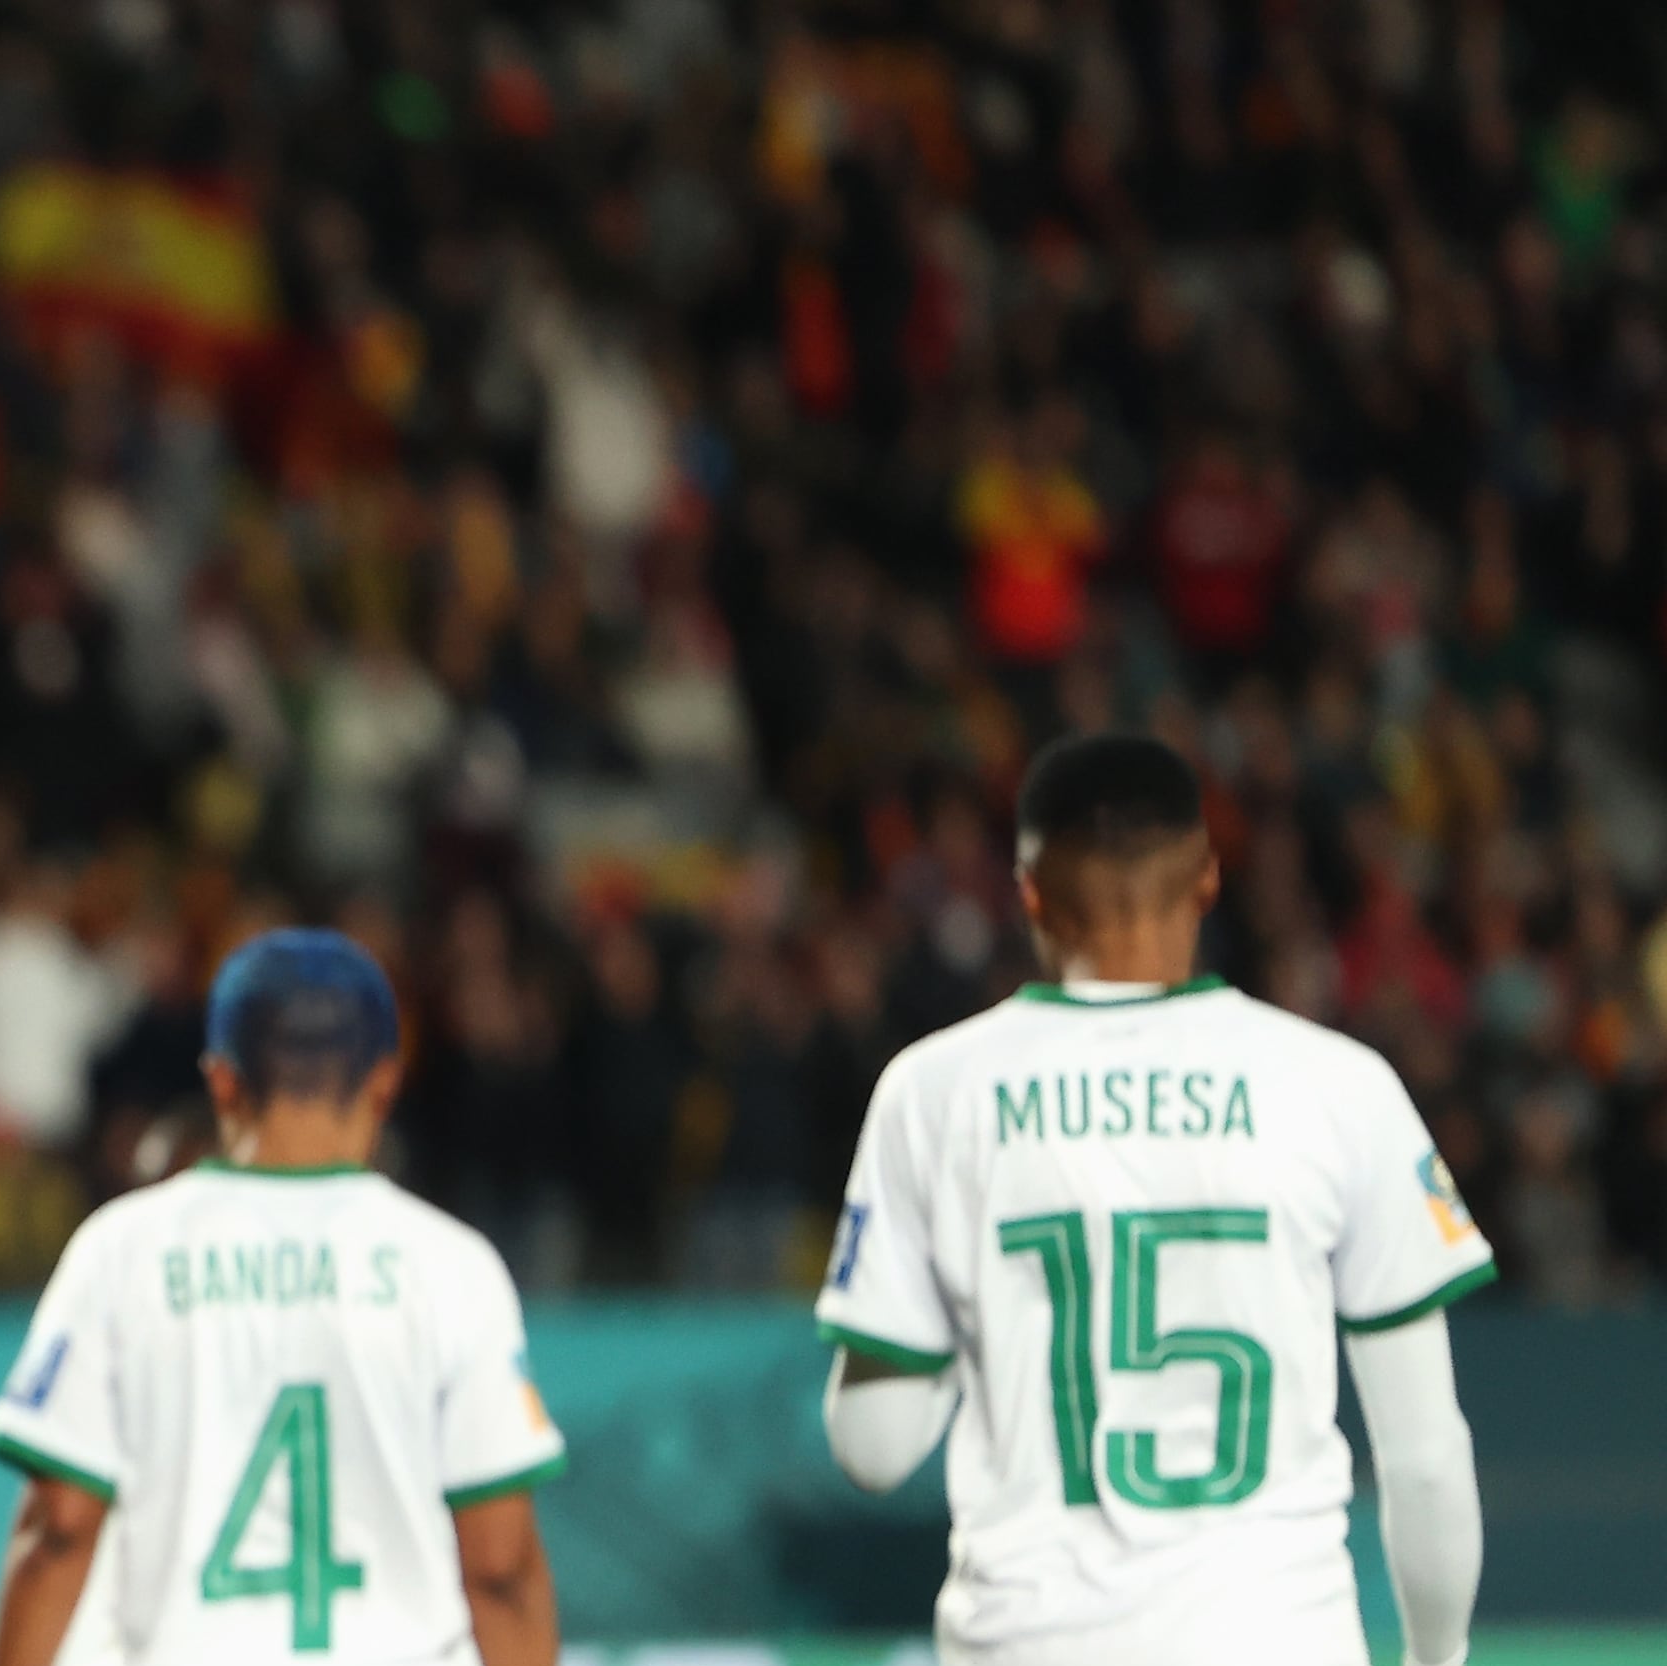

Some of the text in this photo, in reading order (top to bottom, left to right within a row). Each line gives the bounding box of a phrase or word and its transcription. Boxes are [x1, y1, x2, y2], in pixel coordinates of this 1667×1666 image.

[995, 1070, 1255, 1144] MUSESA
[164, 1238, 338, 1316] BANDA
[997, 1208, 1271, 1511] 15
[201, 1384, 365, 1653] 4
